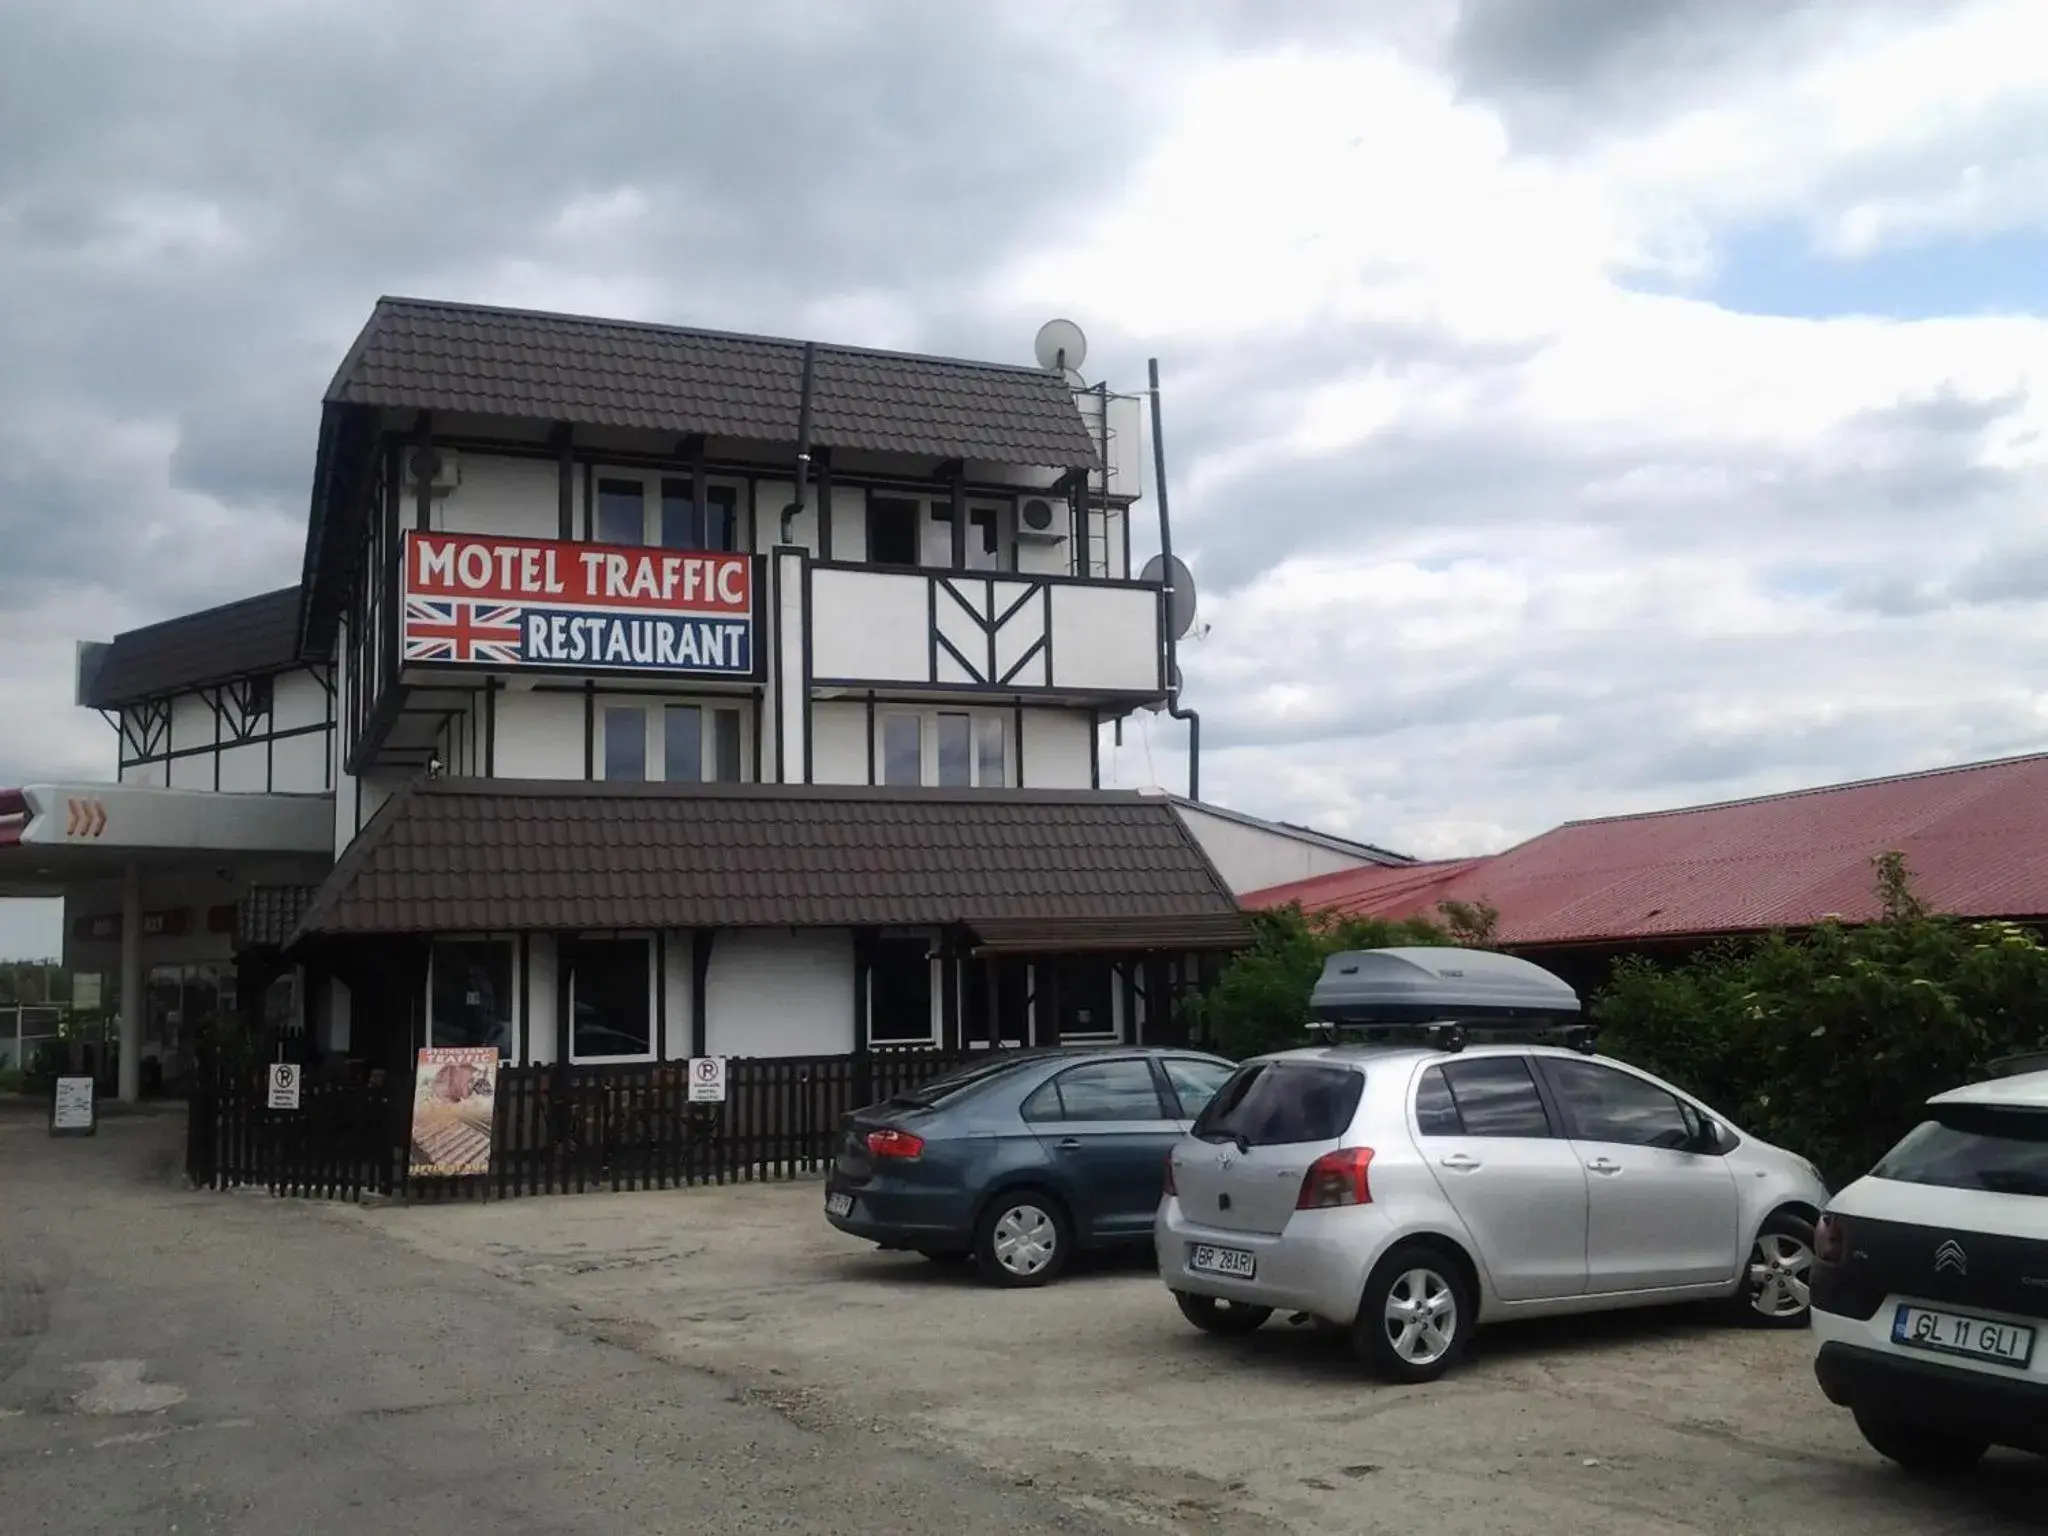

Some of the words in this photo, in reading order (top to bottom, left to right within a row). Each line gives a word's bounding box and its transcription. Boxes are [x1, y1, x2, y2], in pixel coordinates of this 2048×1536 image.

[416, 540, 565, 594] MOTEL
[580, 551, 744, 605] TRAFFIC
[528, 614, 745, 667] RESTAURANT
[426, 1054, 491, 1063] TRAFFIC
[1198, 1247, 1214, 1266] BR
[1914, 1314, 1942, 1342] GL
[1953, 1320, 1971, 1346] 11
[1979, 1326, 2018, 1356] GLI
